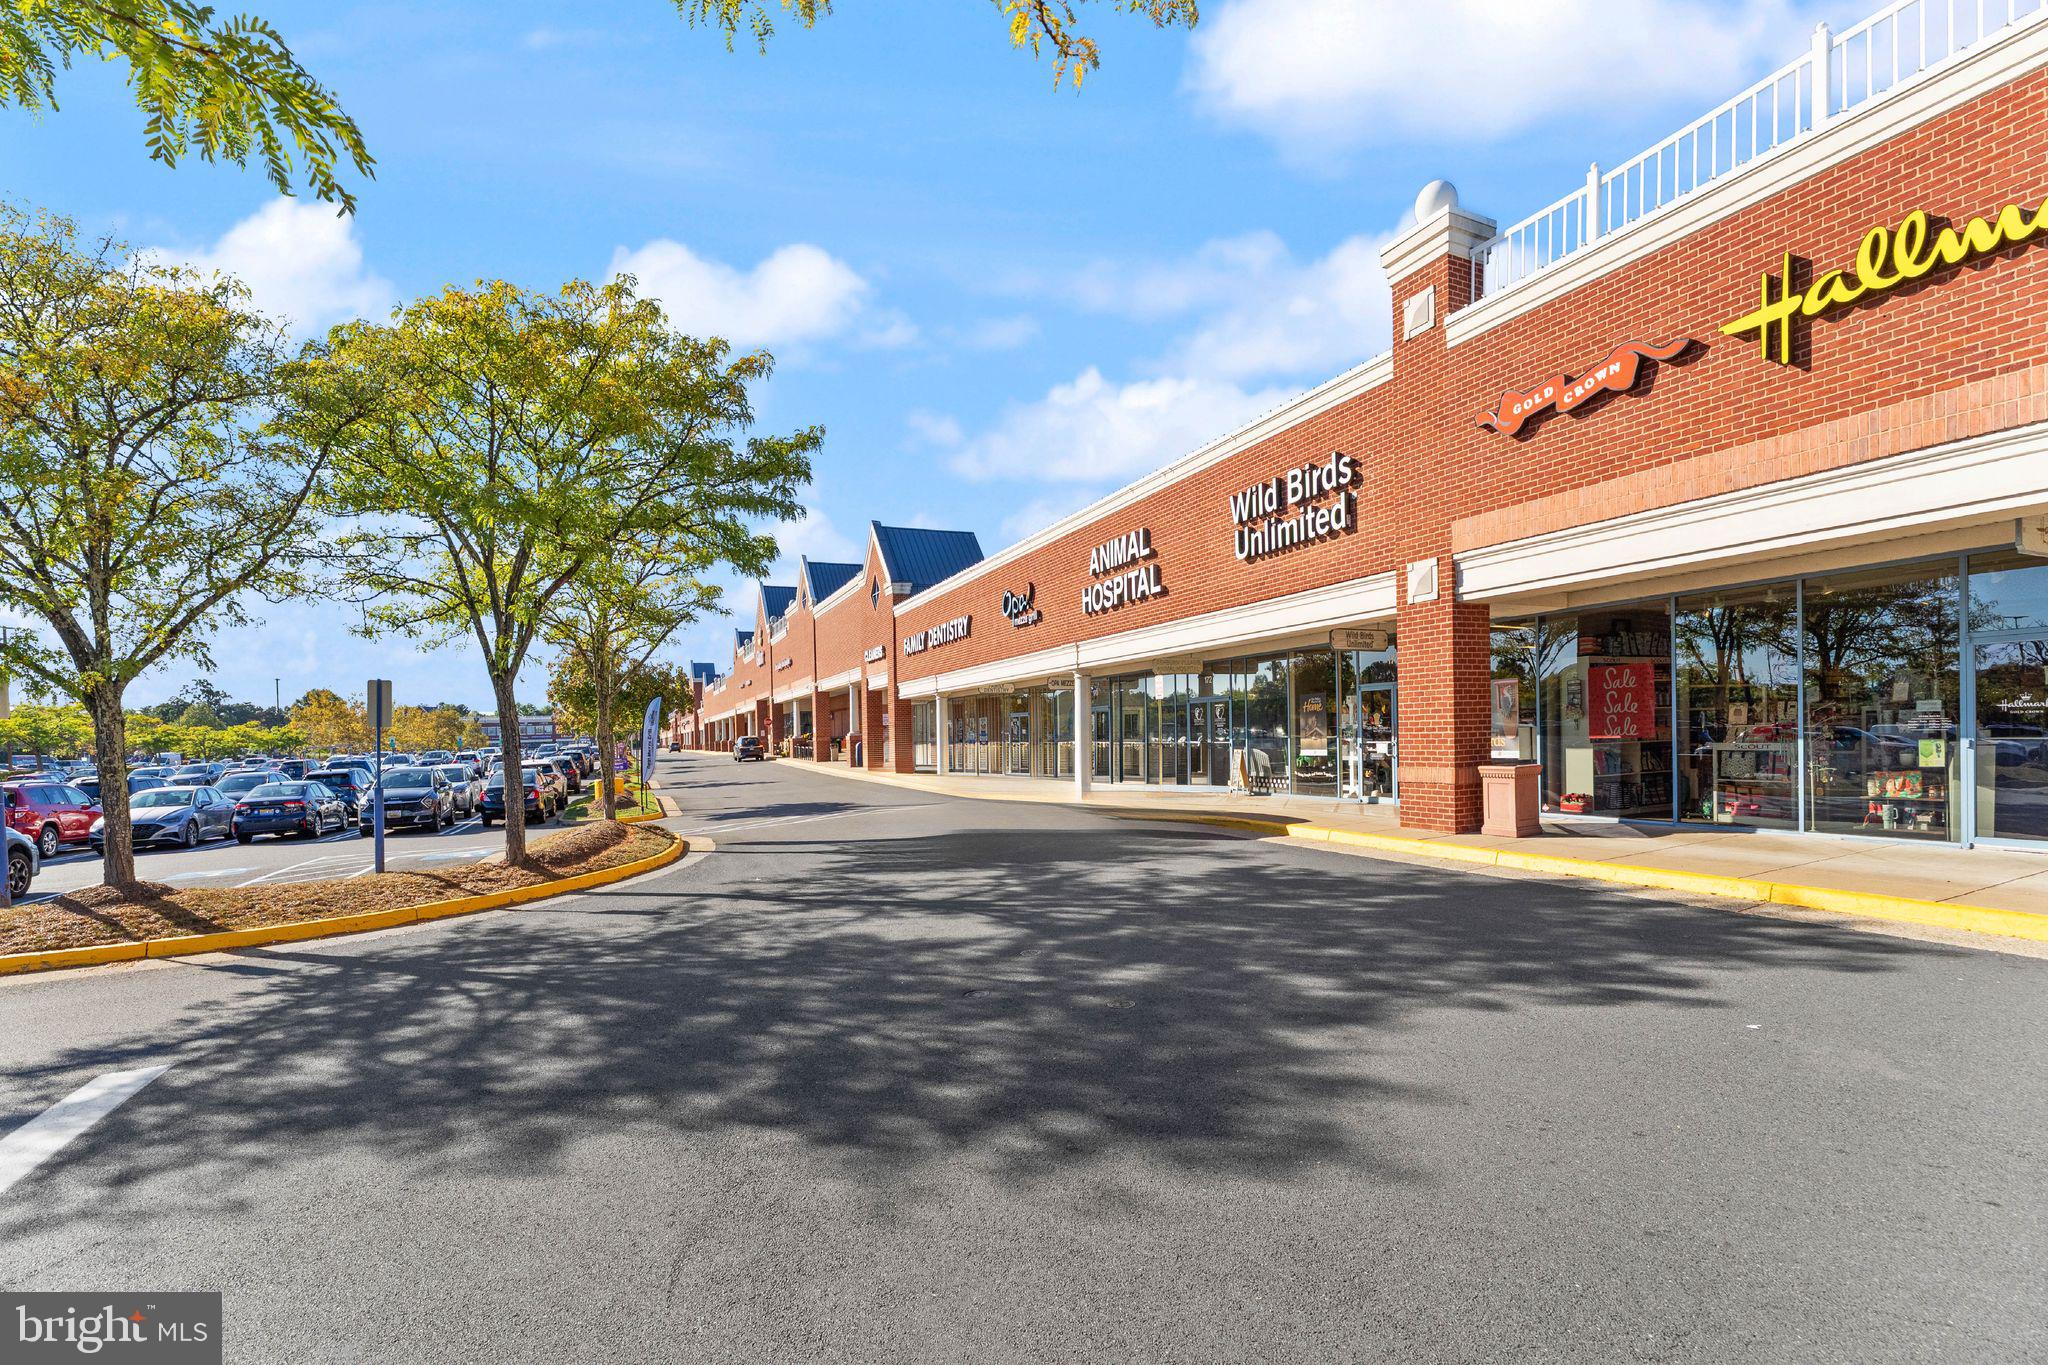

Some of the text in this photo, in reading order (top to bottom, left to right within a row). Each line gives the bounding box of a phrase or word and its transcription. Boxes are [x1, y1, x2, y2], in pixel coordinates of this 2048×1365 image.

[1511, 360, 1622, 416] GOLD CROWN
[1228, 450, 1354, 526] Wild Birds
[1234, 490, 1349, 561] Unlimited
[1089, 526, 1150, 577] ANIMAL
[1081, 563, 1162, 615] HOSPITAL
[903, 615, 970, 658] FAMILY DENTISTRY
[1346, 630, 1375, 640] Wild Birds
[1347, 639, 1374, 649] Unlimited
[1603, 667, 1637, 690] Sale
[1604, 691, 1639, 714] Sale
[1491, 736, 1506, 747] rds
[1605, 714, 1640, 737] Sale
